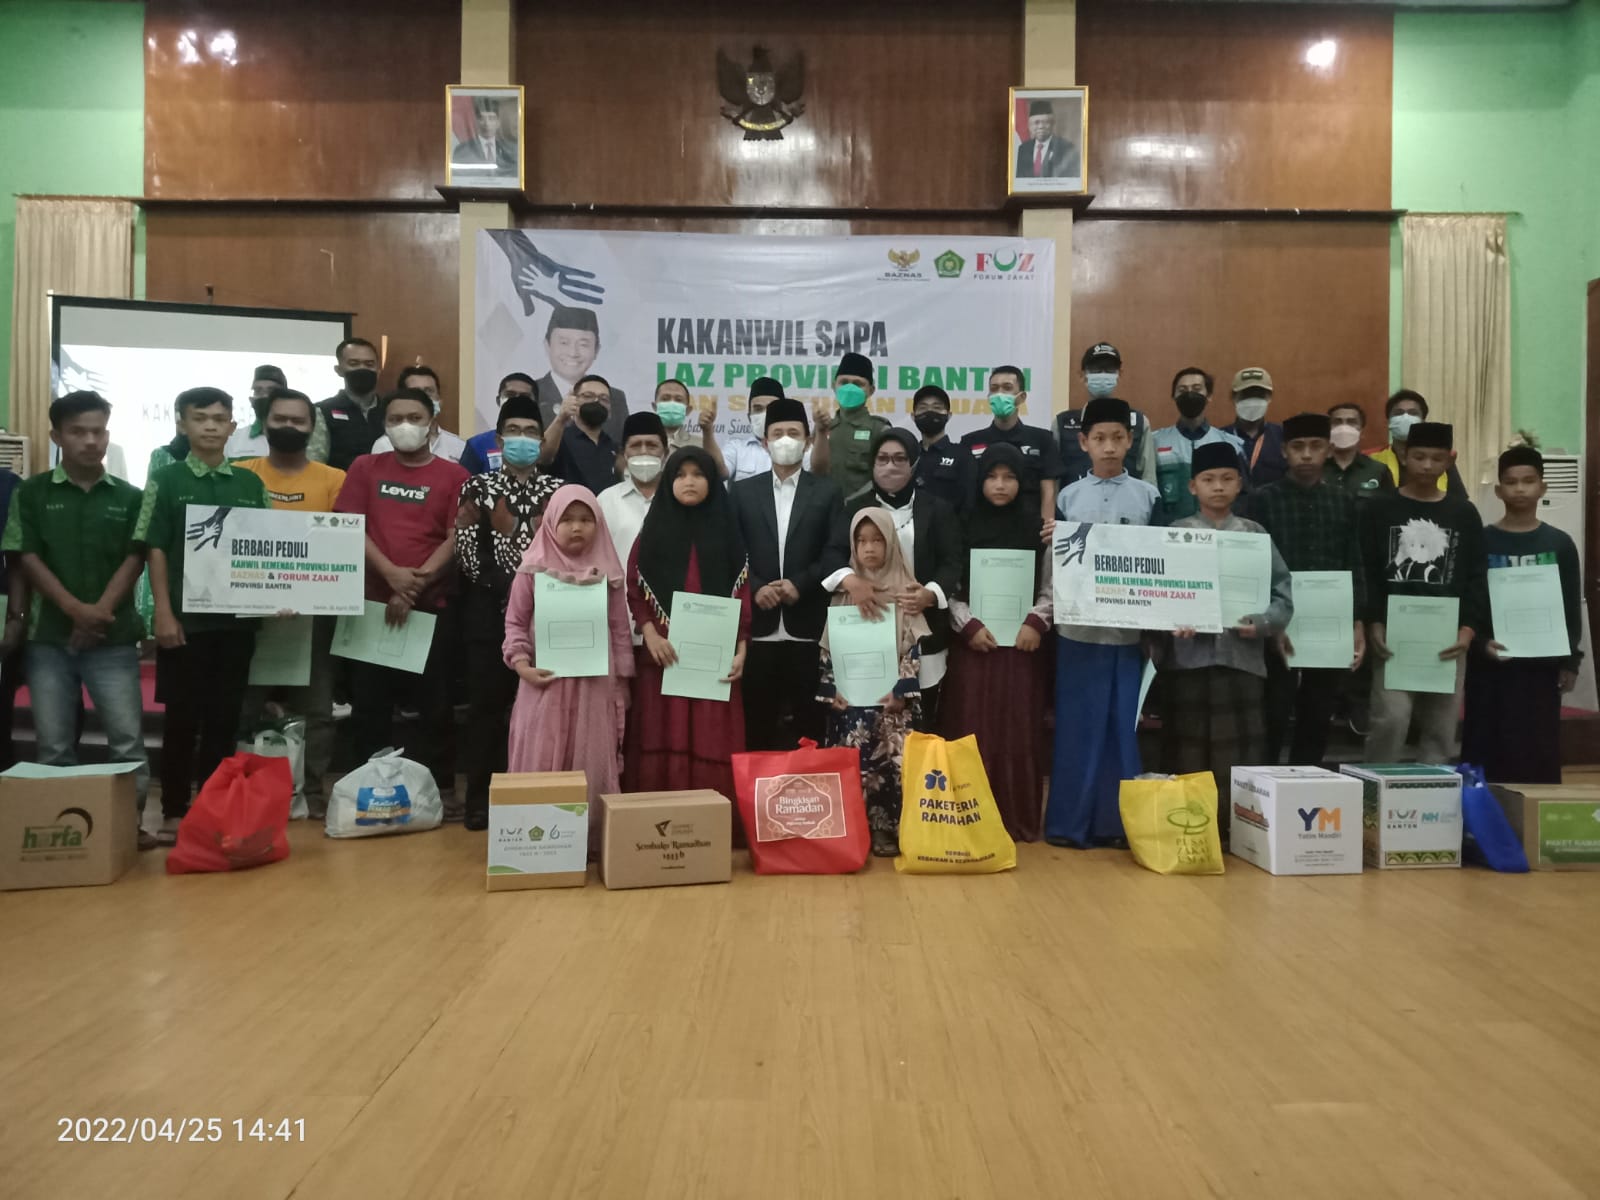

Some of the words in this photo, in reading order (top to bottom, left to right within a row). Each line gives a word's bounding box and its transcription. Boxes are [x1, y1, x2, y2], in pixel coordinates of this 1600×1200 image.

[657, 317, 808, 357] KAKANWIL
[815, 319, 888, 358] SAPA
[231, 539, 274, 558] BERBAGI
[276, 541, 309, 559] PEDULI
[296, 562, 330, 572] PROVINSI
[331, 563, 358, 573] BANTEN
[1094, 554, 1133, 573] BERBAGI
[1134, 557, 1165, 575] PEDULI
[268, 572, 275, 580] &
[277, 573, 310, 582] FORUM
[312, 573, 340, 582] ZAKAT
[230, 581, 264, 590] PROVINSI
[1154, 578, 1186, 589] PROVINSI
[1187, 580, 1214, 590] BANTEN
[1129, 588, 1136, 596] &
[1137, 588, 1168, 599] FORUM
[1170, 590, 1197, 600] ZAKAT
[1095, 596, 1127, 606] PROVINSI
[1127, 598, 1152, 607] BANTEN
[779, 796, 820, 806] Bingkisan
[919, 798, 979, 813] PAKETERIA
[775, 803, 824, 815] Ramadan
[1298, 807, 1342, 831] YM
